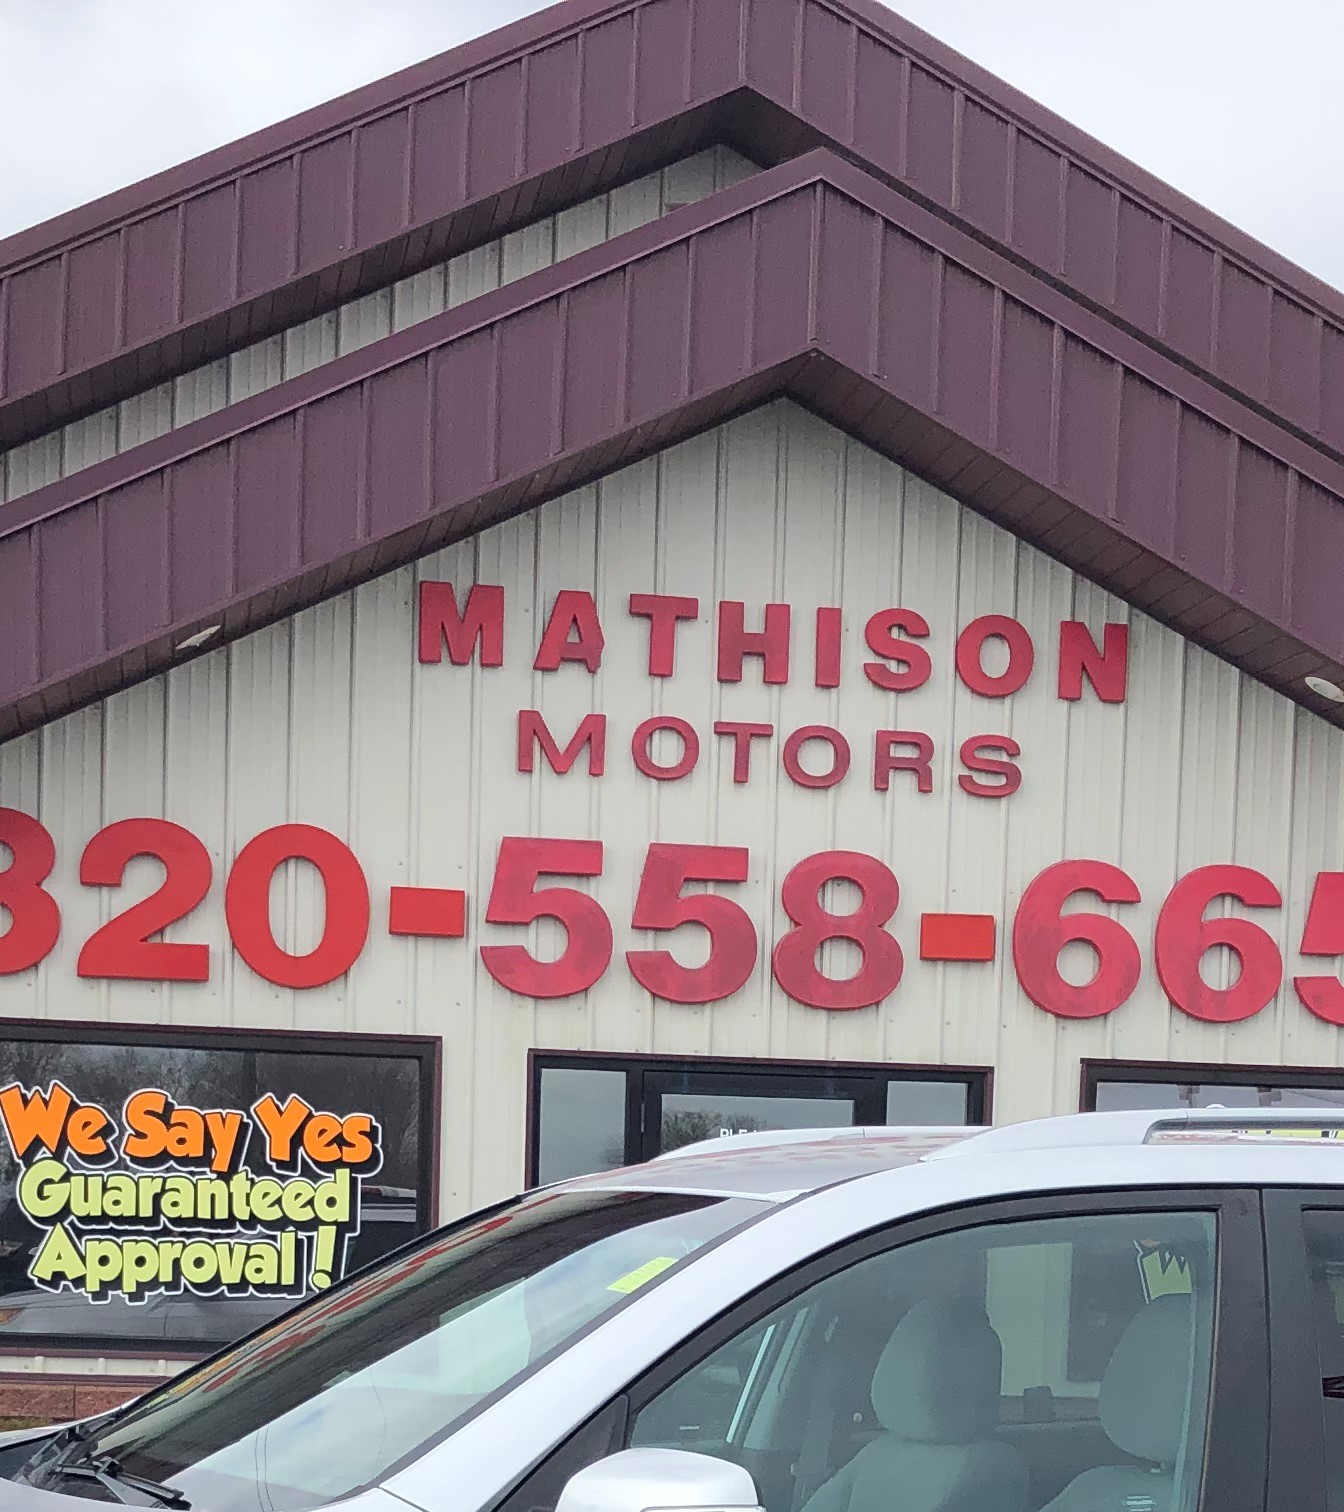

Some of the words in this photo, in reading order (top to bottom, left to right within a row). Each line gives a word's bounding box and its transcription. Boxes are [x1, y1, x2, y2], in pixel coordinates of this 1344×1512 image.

[417, 580, 1129, 704] MATHISON
[516, 710, 1023, 798] MOTORS
[124, 1089, 243, 1173] Say
[253, 1093, 376, 1163] Yes
[19, 1158, 352, 1223] Guaranteed
